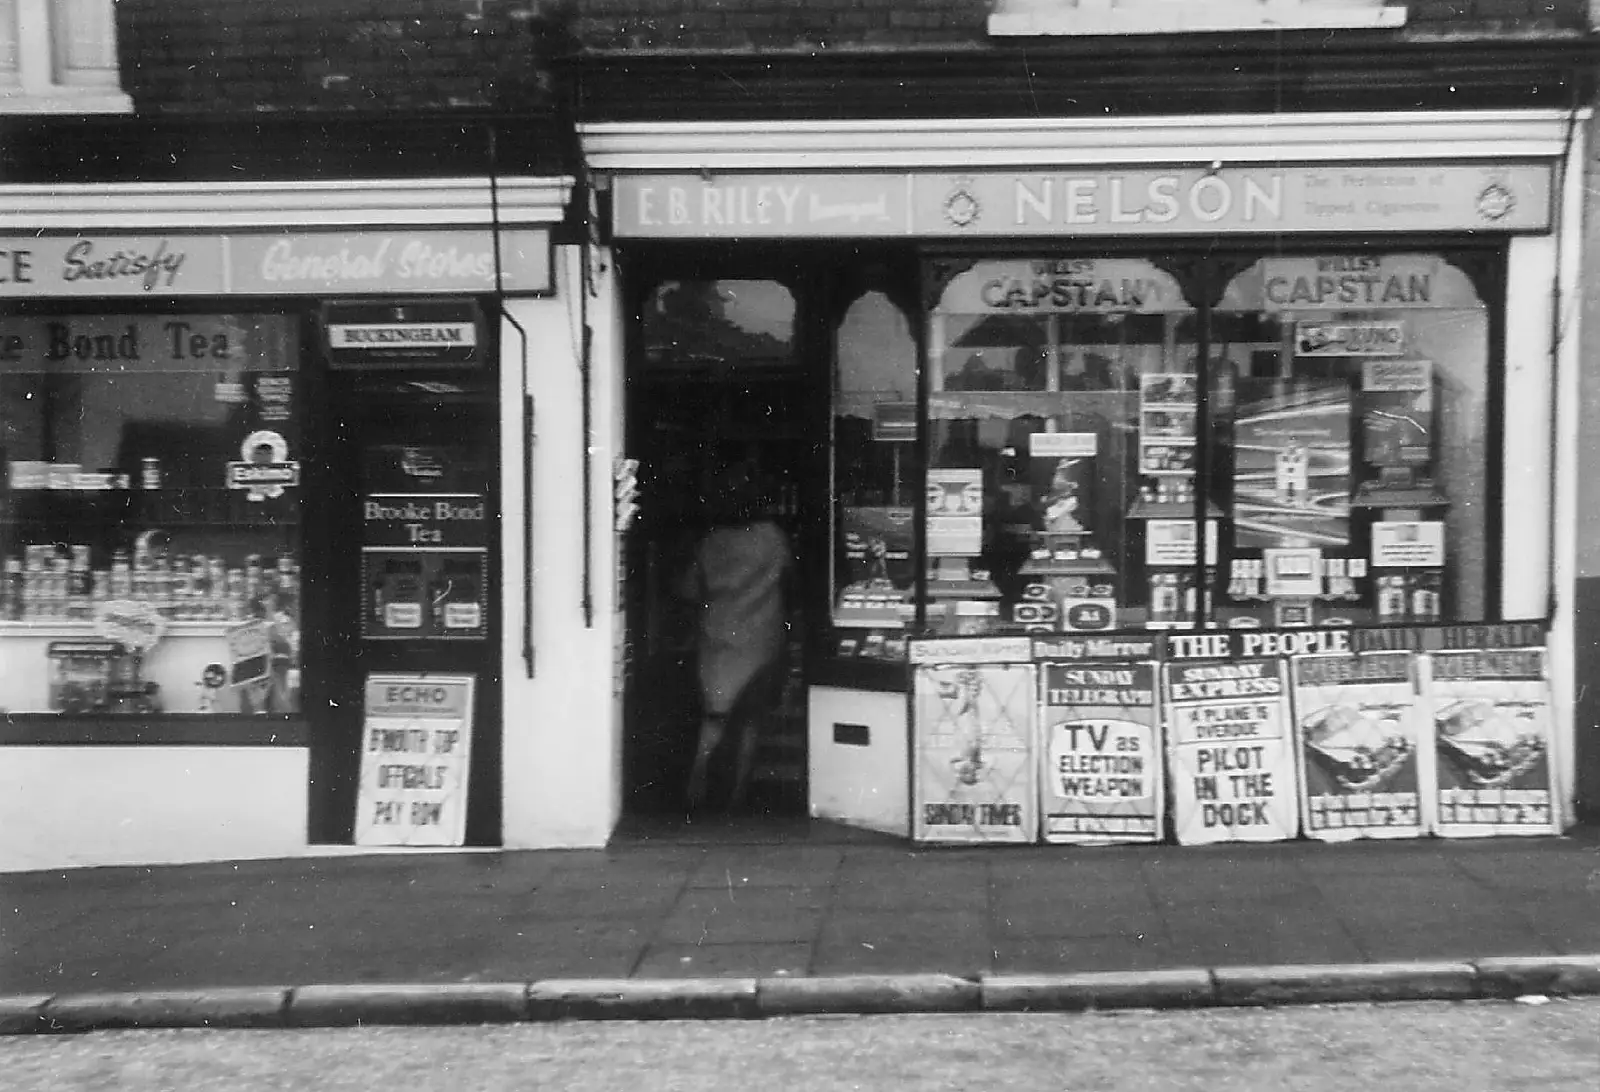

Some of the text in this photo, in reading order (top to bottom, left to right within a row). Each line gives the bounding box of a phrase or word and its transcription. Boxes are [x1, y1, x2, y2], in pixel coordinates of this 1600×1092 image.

[702, 185, 801, 225] RILEY
[1014, 174, 1283, 225] NELSON
[63, 239, 186, 291] Satisfy
[263, 237, 393, 282] General
[980, 278, 1146, 308] CAPSTAN
[1265, 274, 1431, 304] CAPSTAN
[0, 321, 231, 361] e Bond Tea
[343, 327, 463, 343] BUCKINGHAM
[364, 501, 485, 521] Brooke Bond
[404, 522, 442, 542] Tea
[1033, 639, 1153, 659] Daily Mirror
[1168, 630, 1350, 658] THE PEOPLE
[386, 686, 448, 704] ECHO
[1065, 724, 1140, 751] TV as
[1059, 755, 1144, 774] ELECTION
[1197, 745, 1265, 773] PILOT
[1061, 777, 1144, 797] WEAPON
[1193, 773, 1274, 800] IN THE
[1202, 801, 1270, 828] DOCK
